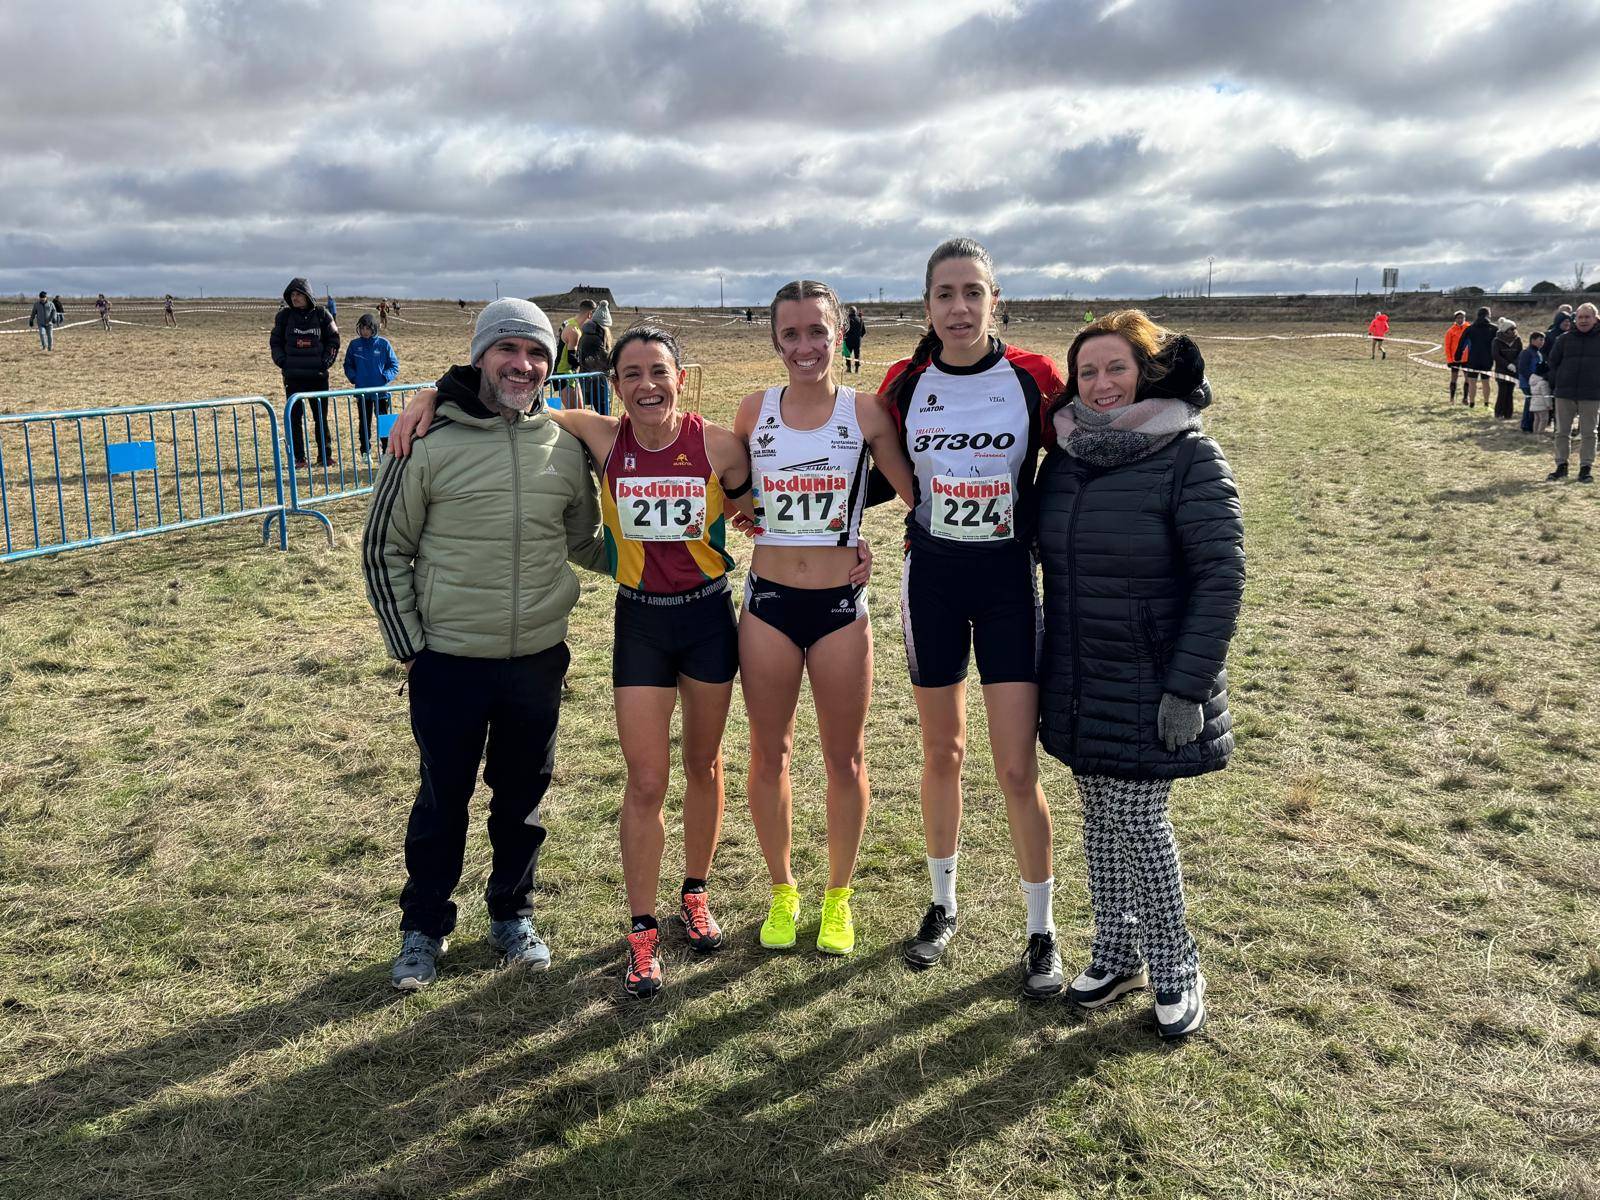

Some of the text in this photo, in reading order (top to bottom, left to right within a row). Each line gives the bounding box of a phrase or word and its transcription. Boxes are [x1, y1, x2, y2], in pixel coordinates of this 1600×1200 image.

[919, 405, 945, 413] VIATOR
[915, 427, 945, 435] TRIATLON
[913, 432, 1016, 453] 37300
[618, 481, 705, 498] bedunia
[763, 475, 847, 492] bedunia
[932, 477, 1010, 499] bedunia
[632, 498, 692, 527] 213
[775, 492, 834, 521] 217
[943, 498, 1001, 527] 224
[647, 595, 684, 606] ARMOUR
